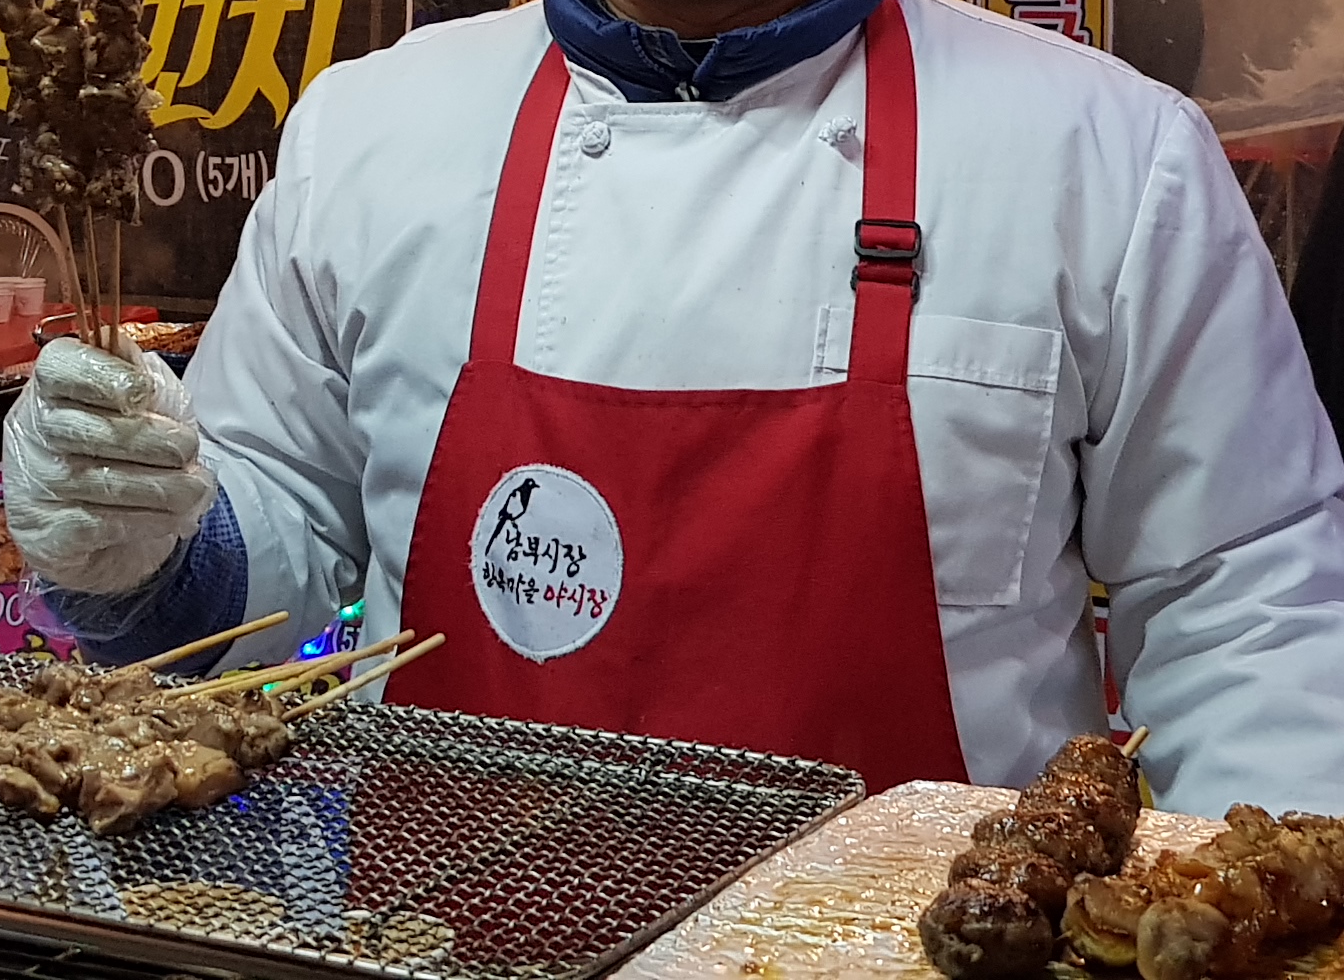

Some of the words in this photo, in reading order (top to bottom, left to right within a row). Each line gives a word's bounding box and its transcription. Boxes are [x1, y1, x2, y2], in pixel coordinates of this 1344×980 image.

[196, 149, 268, 202] (5개)
[506, 522, 587, 578] 남부시장
[543, 580, 608, 619] 야시장
